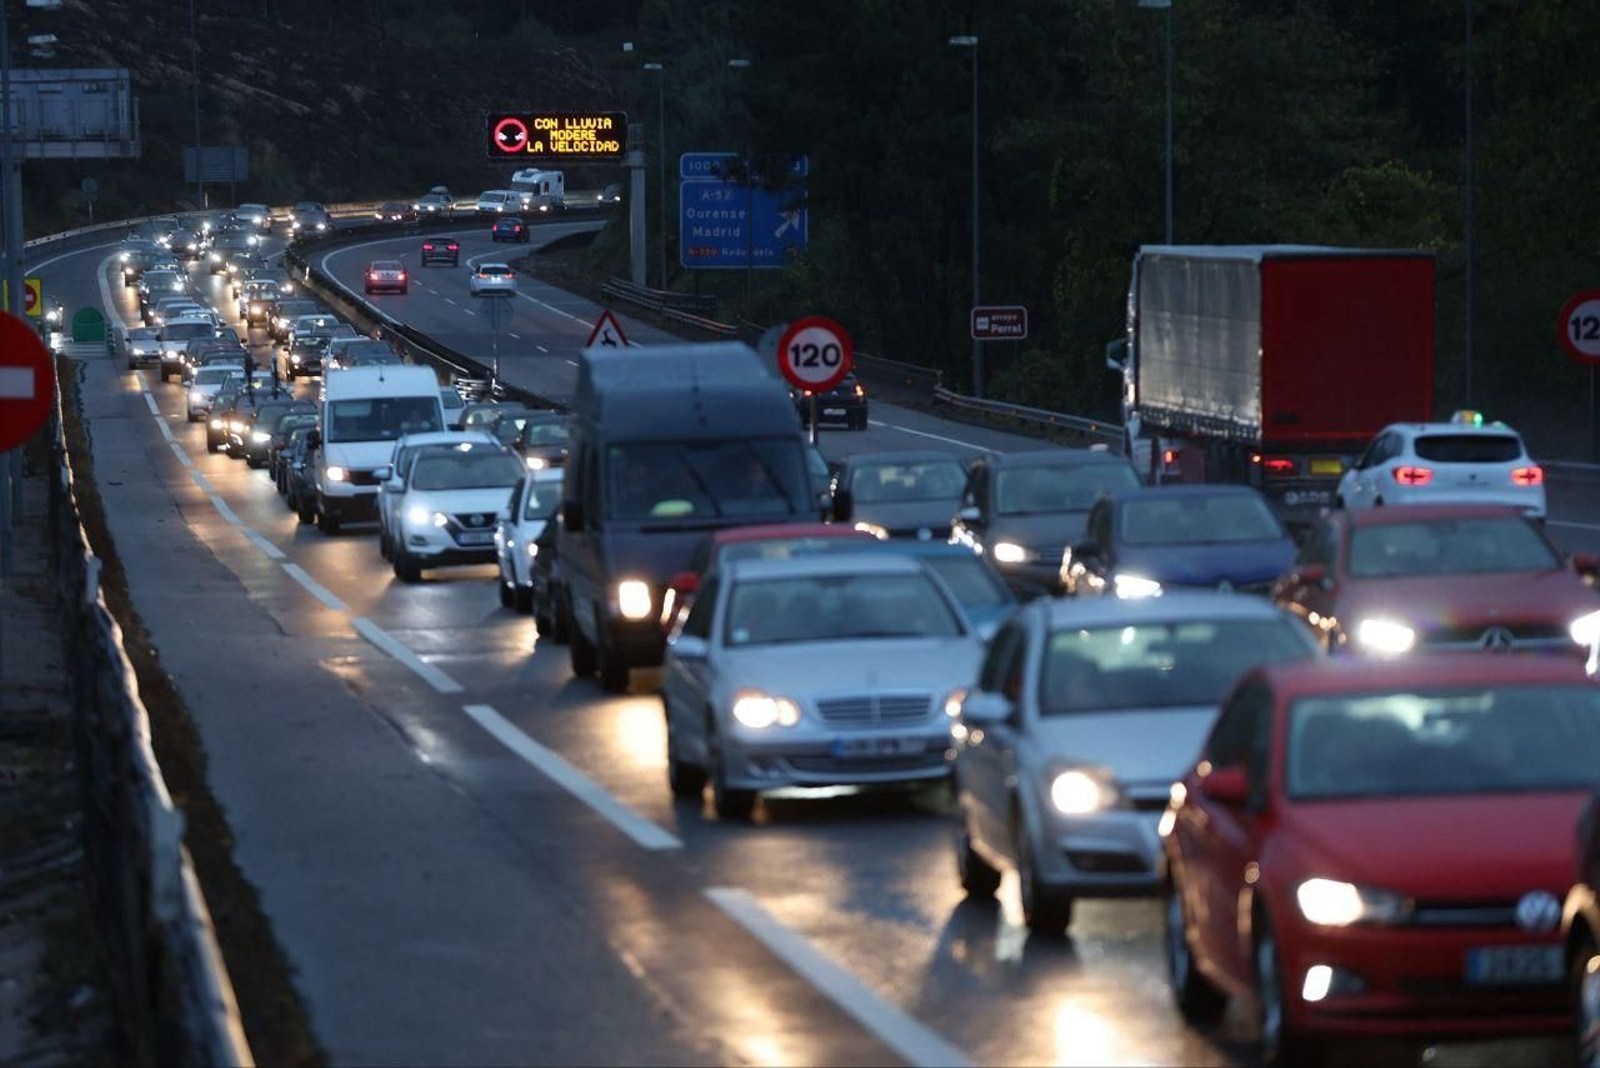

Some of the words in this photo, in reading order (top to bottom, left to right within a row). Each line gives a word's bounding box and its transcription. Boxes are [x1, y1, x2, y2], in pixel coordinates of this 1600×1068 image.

[534, 118, 558, 129] CON
[565, 118, 612, 129] LLUVIA
[550, 130, 596, 140] MODERE
[527, 141, 543, 152] LA
[550, 141, 619, 152] VELOCIDAD
[686, 208, 746, 219] Ourense
[692, 226, 740, 237] Madrid
[1570, 315, 1600, 340] 12
[790, 343, 840, 368] 120
